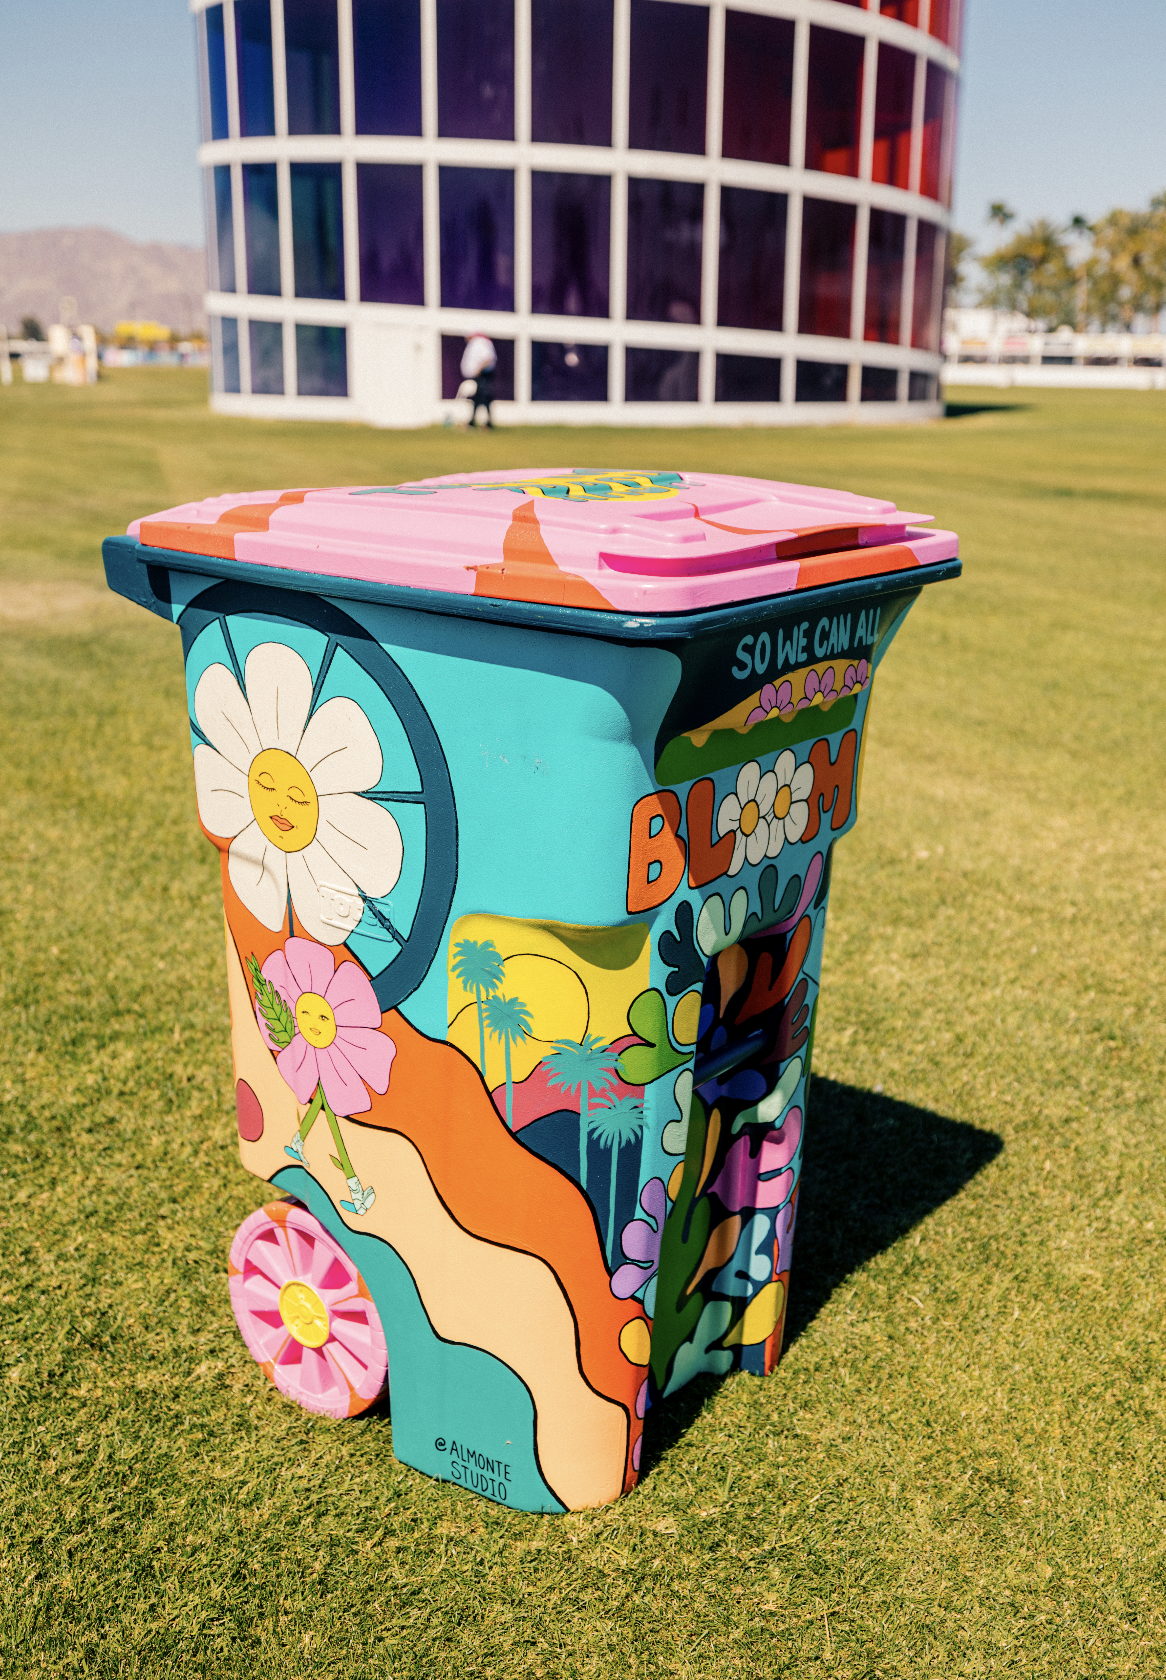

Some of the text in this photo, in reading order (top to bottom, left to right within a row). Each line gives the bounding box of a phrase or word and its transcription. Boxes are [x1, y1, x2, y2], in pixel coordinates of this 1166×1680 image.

[731, 606, 881, 680] SO WE CAN ALL
[626, 728, 857, 915] BLOOM
[435, 1437, 511, 1482] @ALMONTE
[451, 1461, 507, 1501] STUDIO
